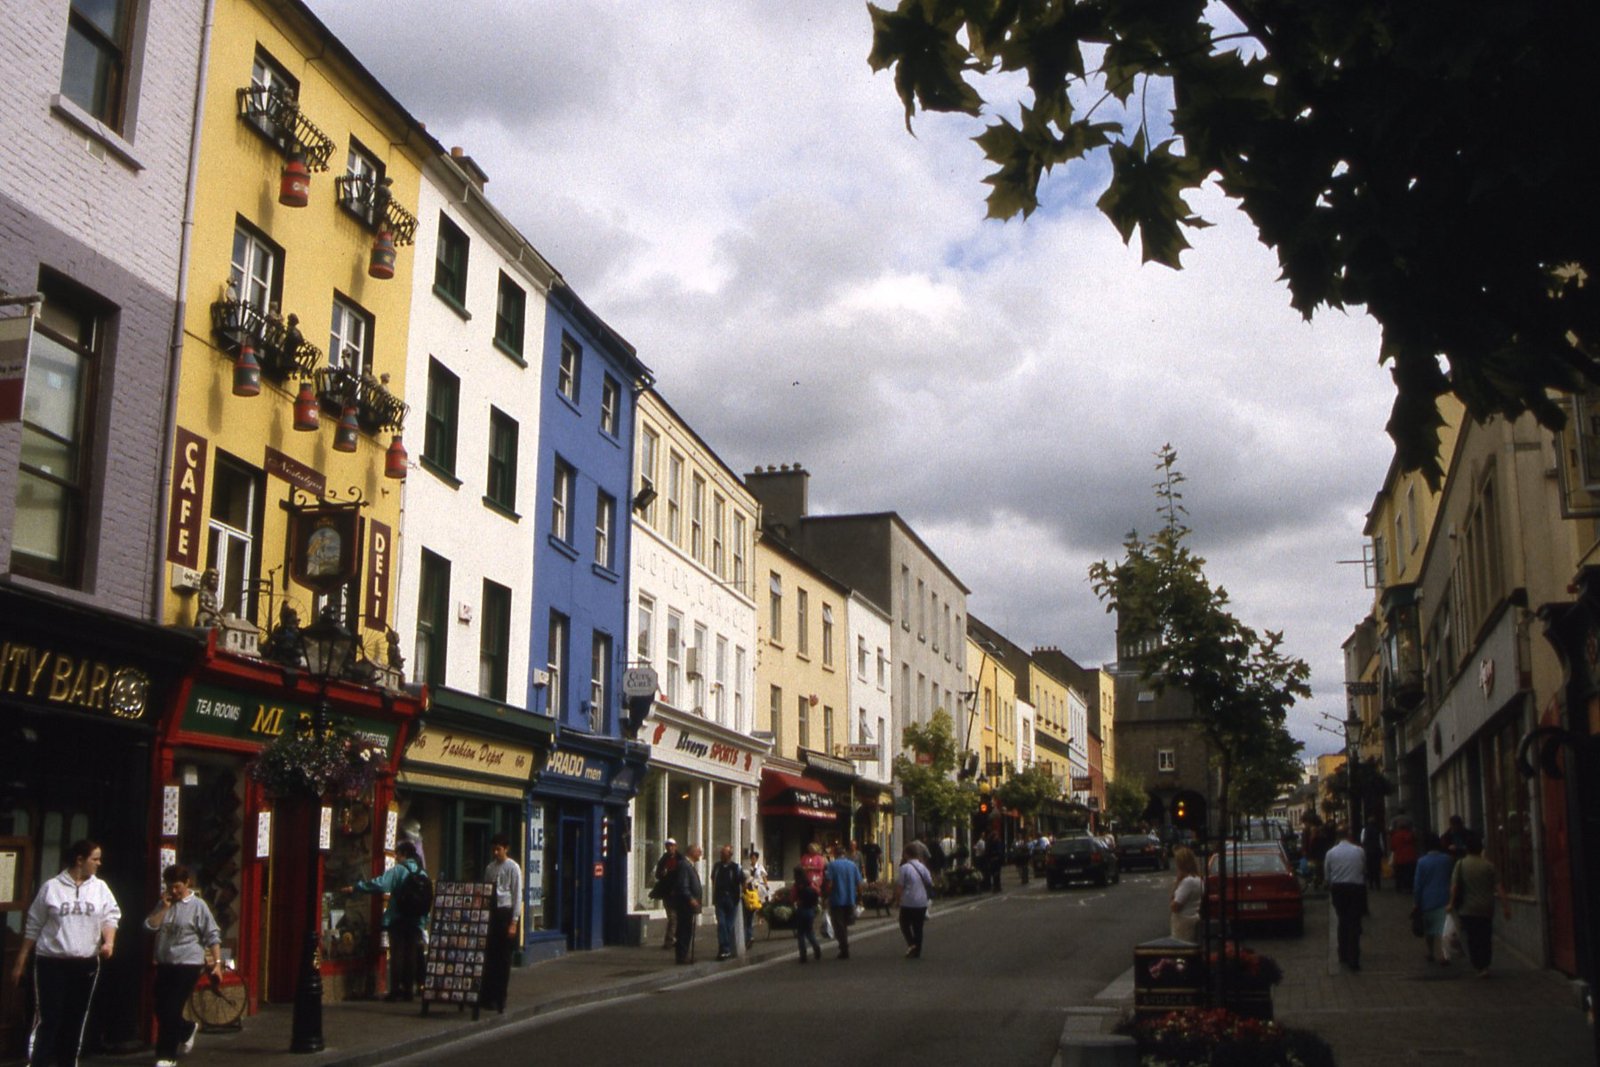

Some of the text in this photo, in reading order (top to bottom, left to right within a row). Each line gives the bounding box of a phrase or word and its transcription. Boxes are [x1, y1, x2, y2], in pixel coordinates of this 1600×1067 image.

[178, 441, 199, 556] CAFE
[374, 532, 386, 618] DELI
[48, 655, 110, 708] BAR
[196, 698, 241, 721] TEA ROOMS
[440, 735, 477, 759] Fashion
[478, 743, 504, 767] Depot
[546, 751, 602, 781] PRADO men
[709, 741, 740, 766] SPORTS
[59, 901, 96, 917] GAP
